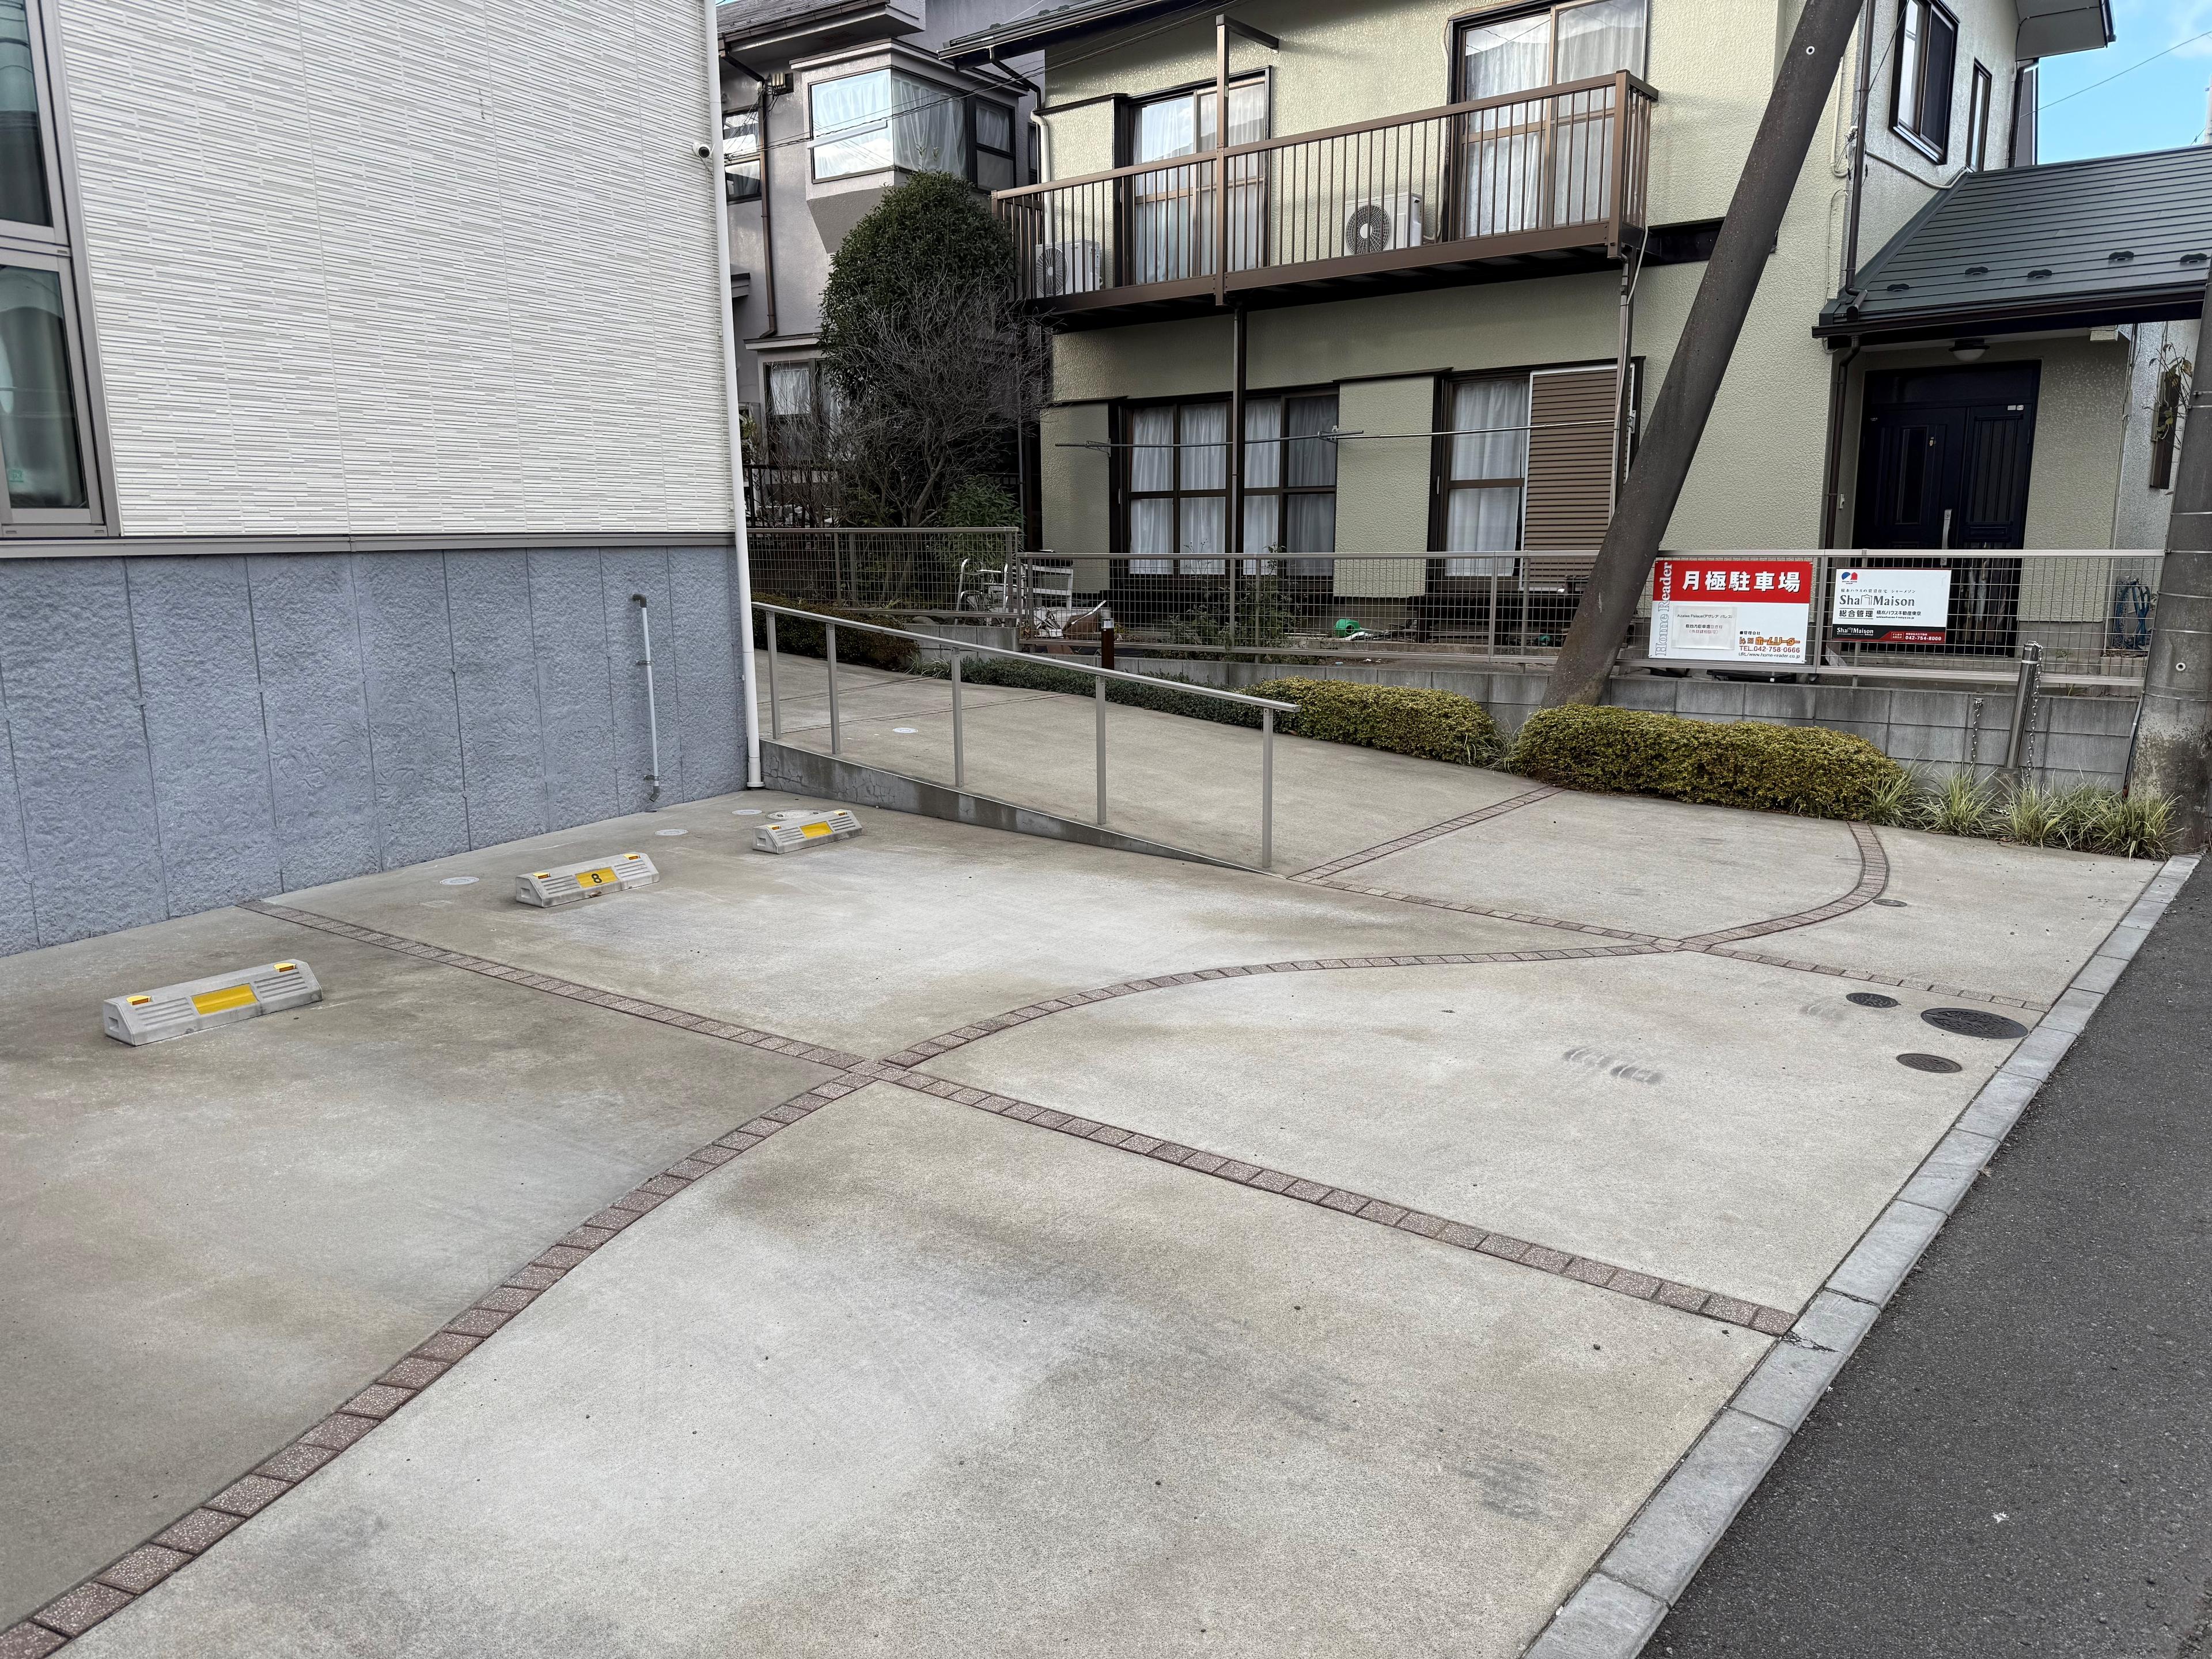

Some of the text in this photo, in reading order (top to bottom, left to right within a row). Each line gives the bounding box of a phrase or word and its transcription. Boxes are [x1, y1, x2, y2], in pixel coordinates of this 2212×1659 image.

[1682, 571, 1801, 593] 月極駐車場
[1655, 562, 1672, 656] Home Reader
[1839, 609, 1873, 618] 総合管理
[591, 873, 603, 884] 8
